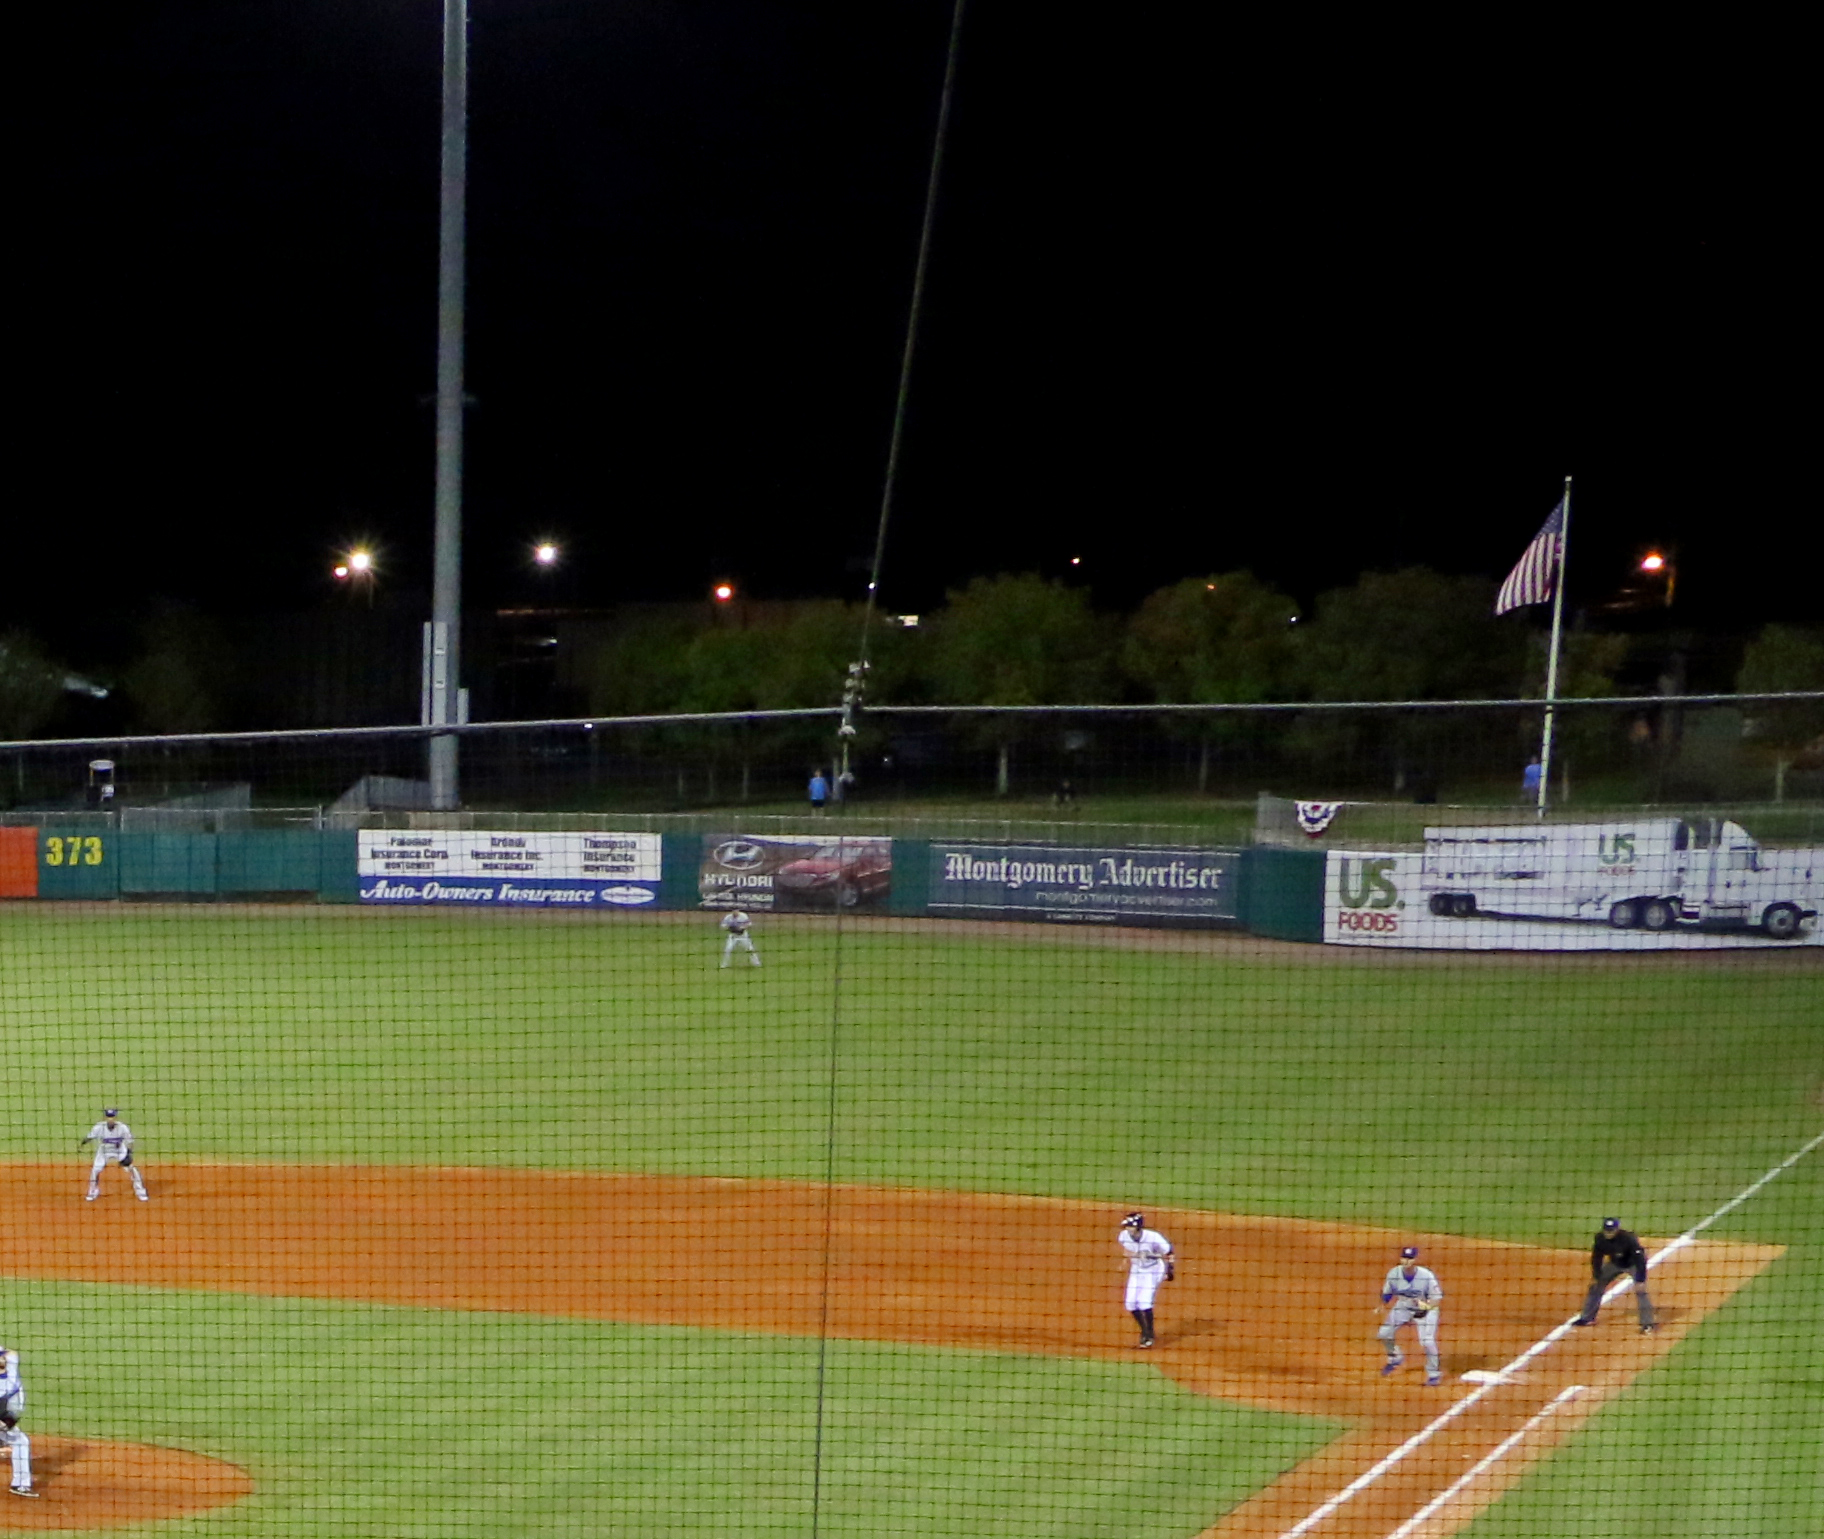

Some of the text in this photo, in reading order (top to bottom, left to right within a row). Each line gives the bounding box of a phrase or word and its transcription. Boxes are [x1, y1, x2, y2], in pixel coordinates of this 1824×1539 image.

[46, 836, 103, 866] 373
[372, 848, 421, 859] Insurance
[471, 849, 522, 860] Insurance
[705, 873, 773, 887] HYUNDAI
[945, 853, 1222, 889] Montgomery Advertiser
[360, 880, 595, 903] Auto-Owners Insurance
[1339, 911, 1398, 931] FOODS
